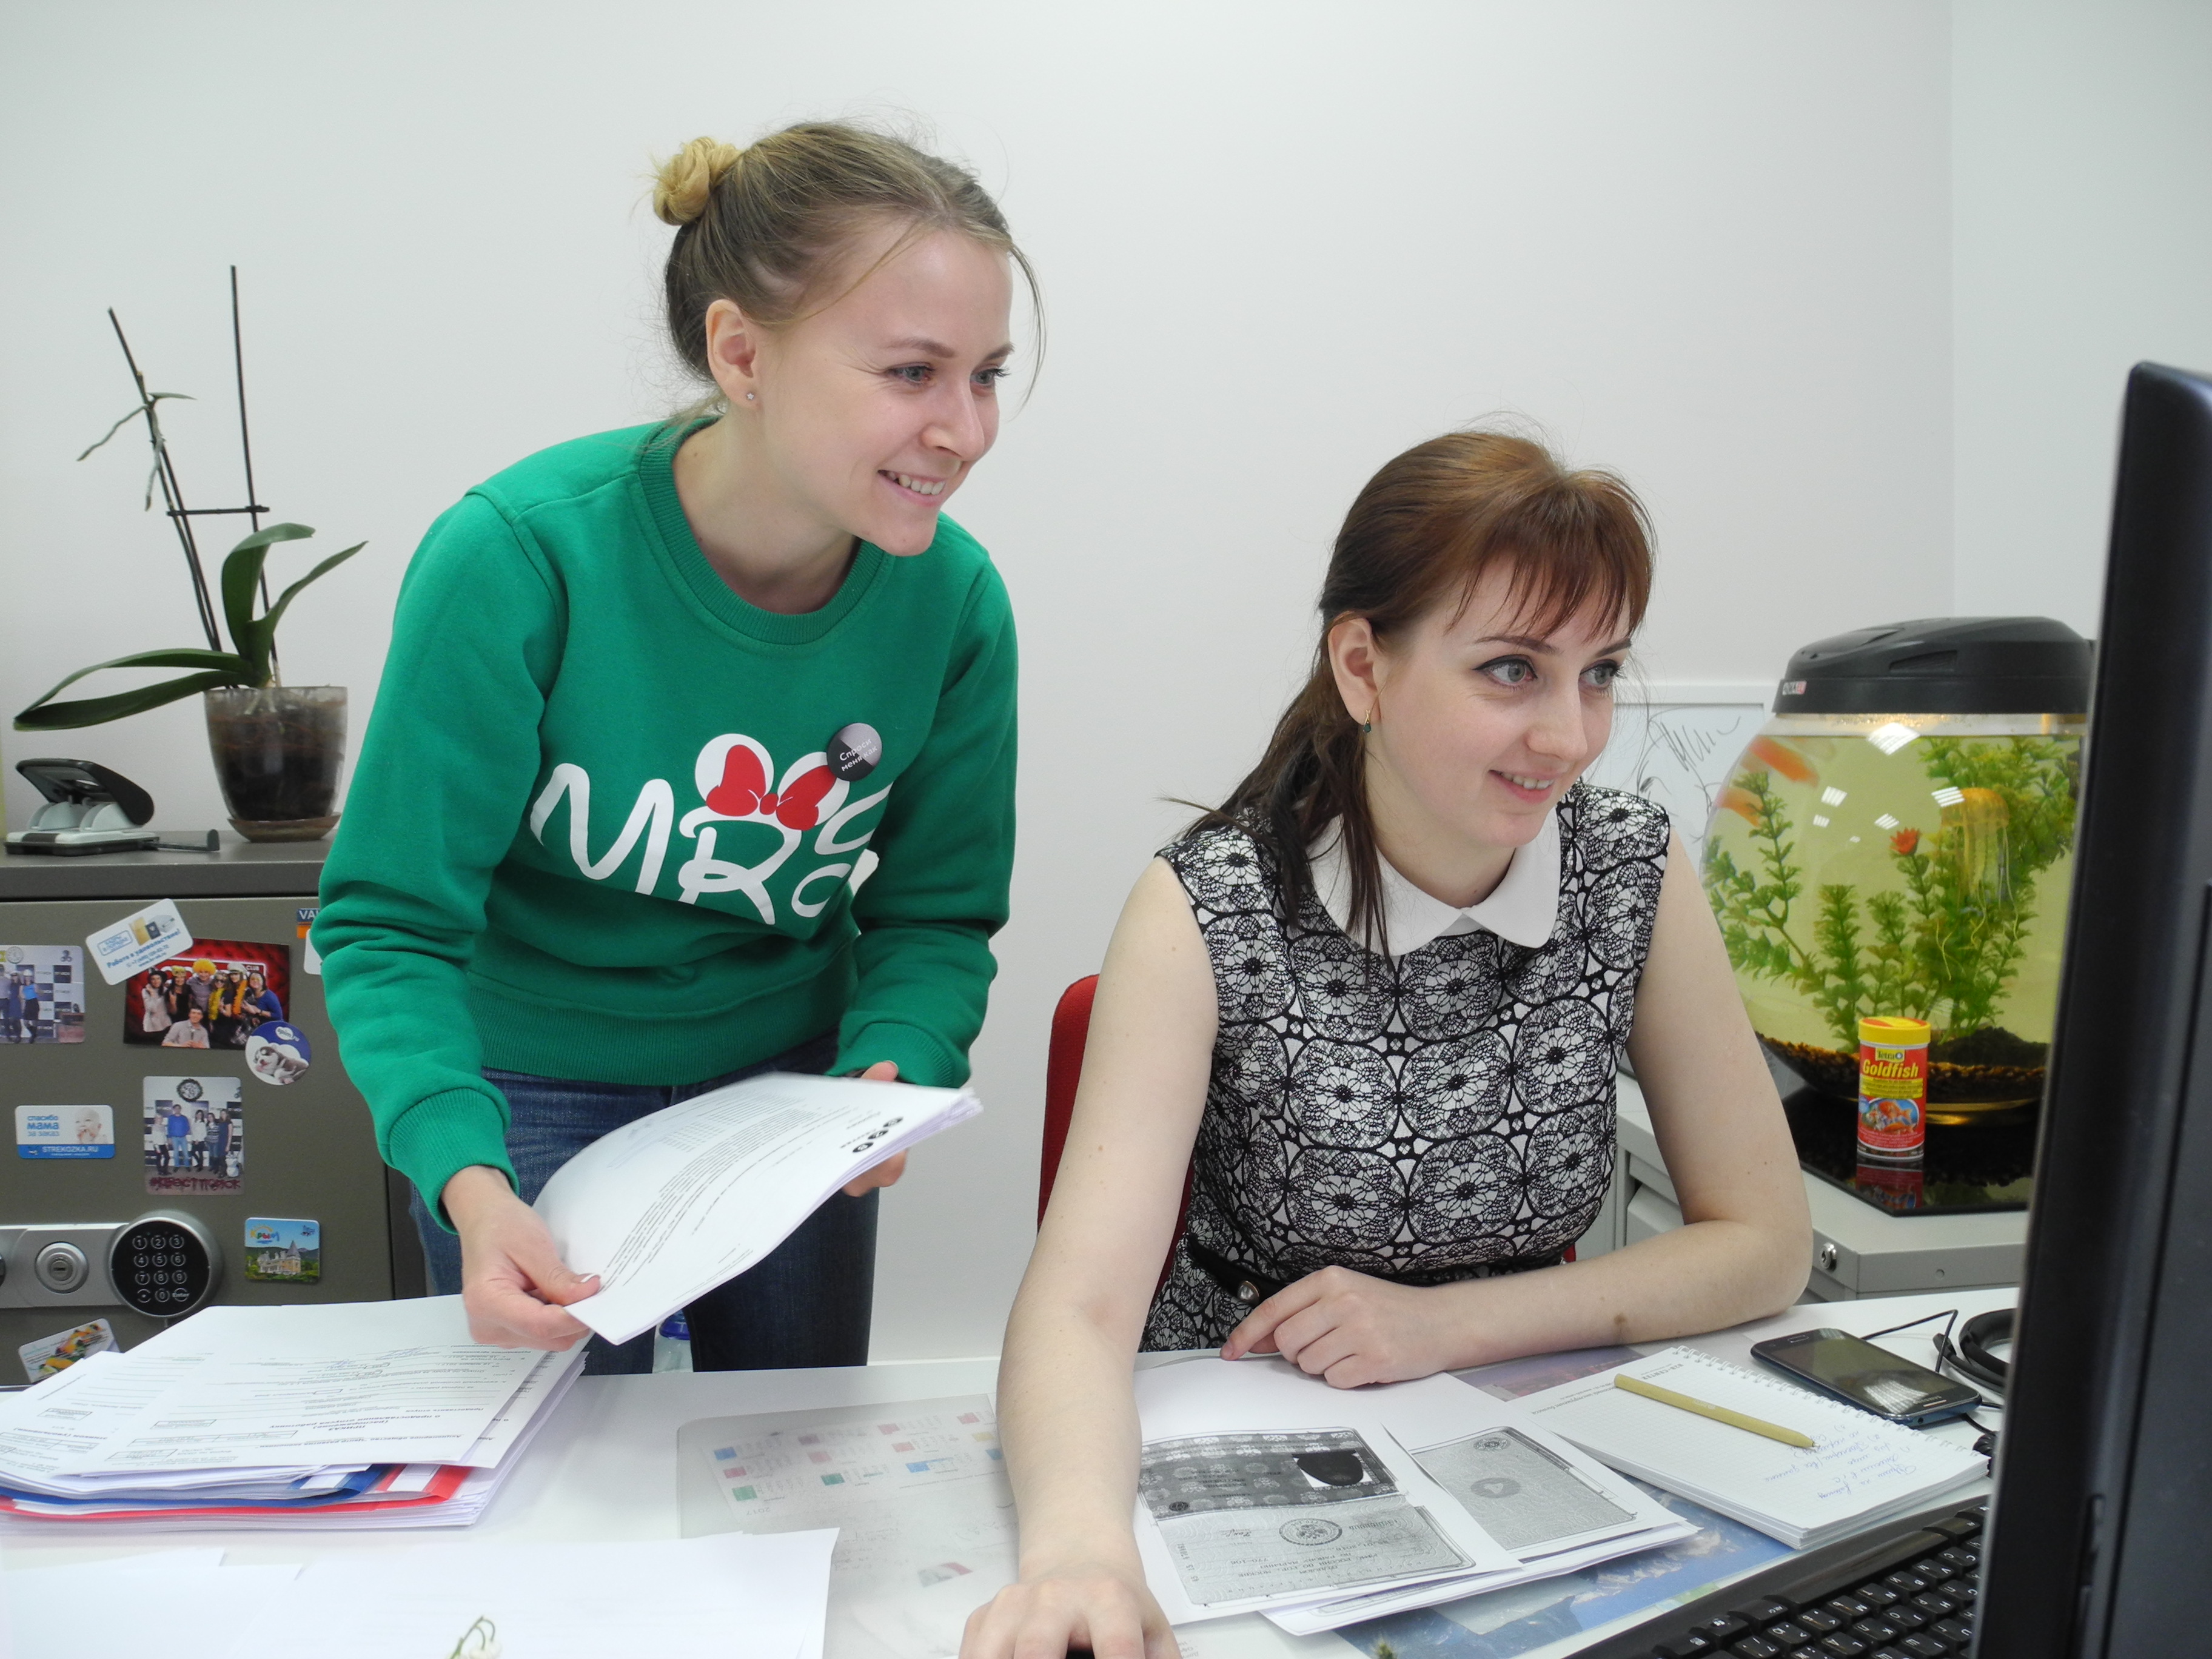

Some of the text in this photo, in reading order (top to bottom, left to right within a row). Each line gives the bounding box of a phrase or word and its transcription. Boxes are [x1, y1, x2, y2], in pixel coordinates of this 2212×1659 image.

[839, 739, 872, 761] Спроси
[841, 746, 878, 772] меня как
[298, 910, 320, 920] VA
[1879, 1051, 1895, 1059] Tetra
[1863, 1059, 1919, 1078] Goldfish
[746, 1507, 771, 1515] 2017
